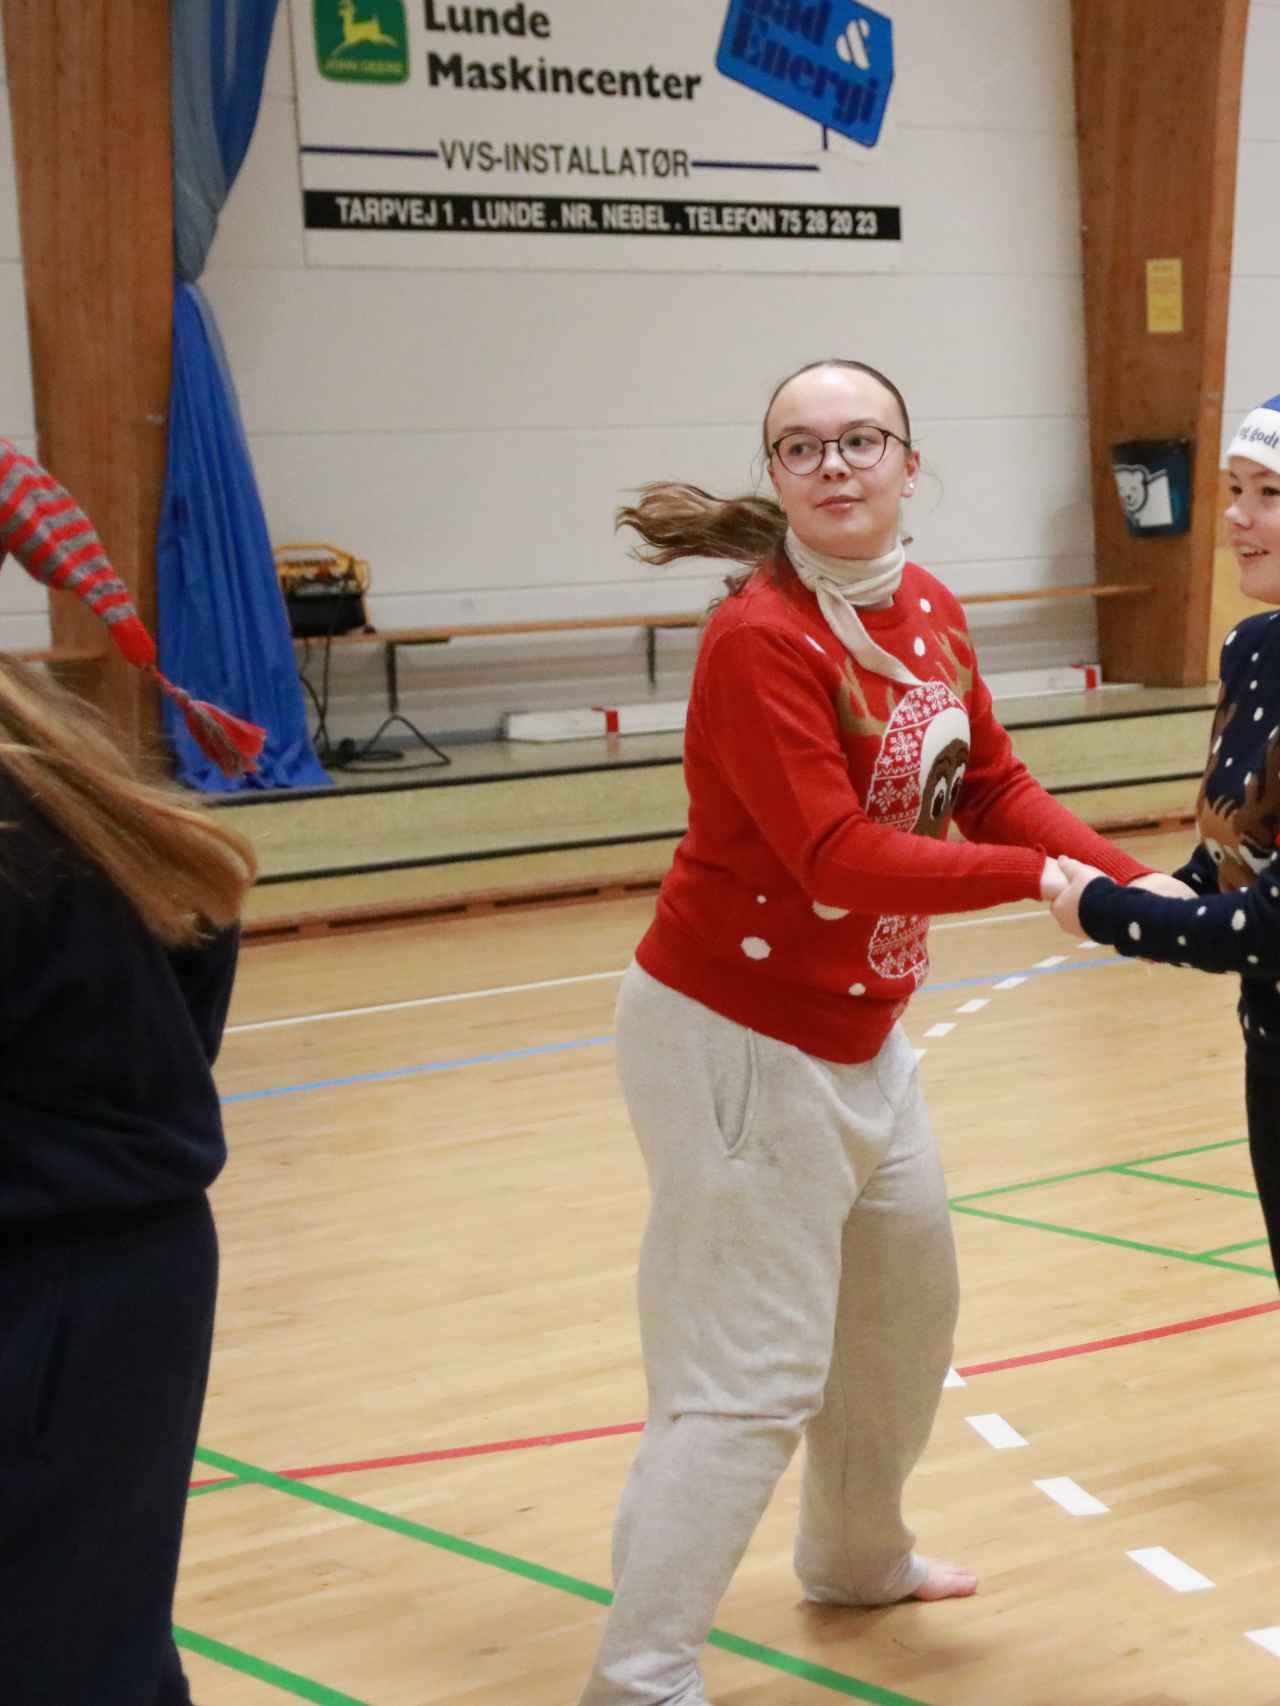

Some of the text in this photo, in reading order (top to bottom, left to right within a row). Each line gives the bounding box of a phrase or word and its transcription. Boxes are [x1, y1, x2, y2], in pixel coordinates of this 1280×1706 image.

[424, 0, 551, 39] Lunde
[835, 17, 871, 71] &
[427, 51, 702, 101] Maskincenter
[730, 12, 879, 125] Energi
[439, 138, 691, 178] VVS-INSTALLATØR
[335, 196, 437, 226] TARPVEJ
[442, 199, 453, 227] 1
[471, 199, 546, 228] LUNDE
[561, 202, 598, 229] NR.
[601, 203, 671, 231] NEBEL
[685, 205, 776, 233] TELEFON
[780, 208, 802, 234] 75
[830, 210, 854, 235] 20
[855, 211, 878, 236] 23
[1248, 427, 1280, 448] godt
